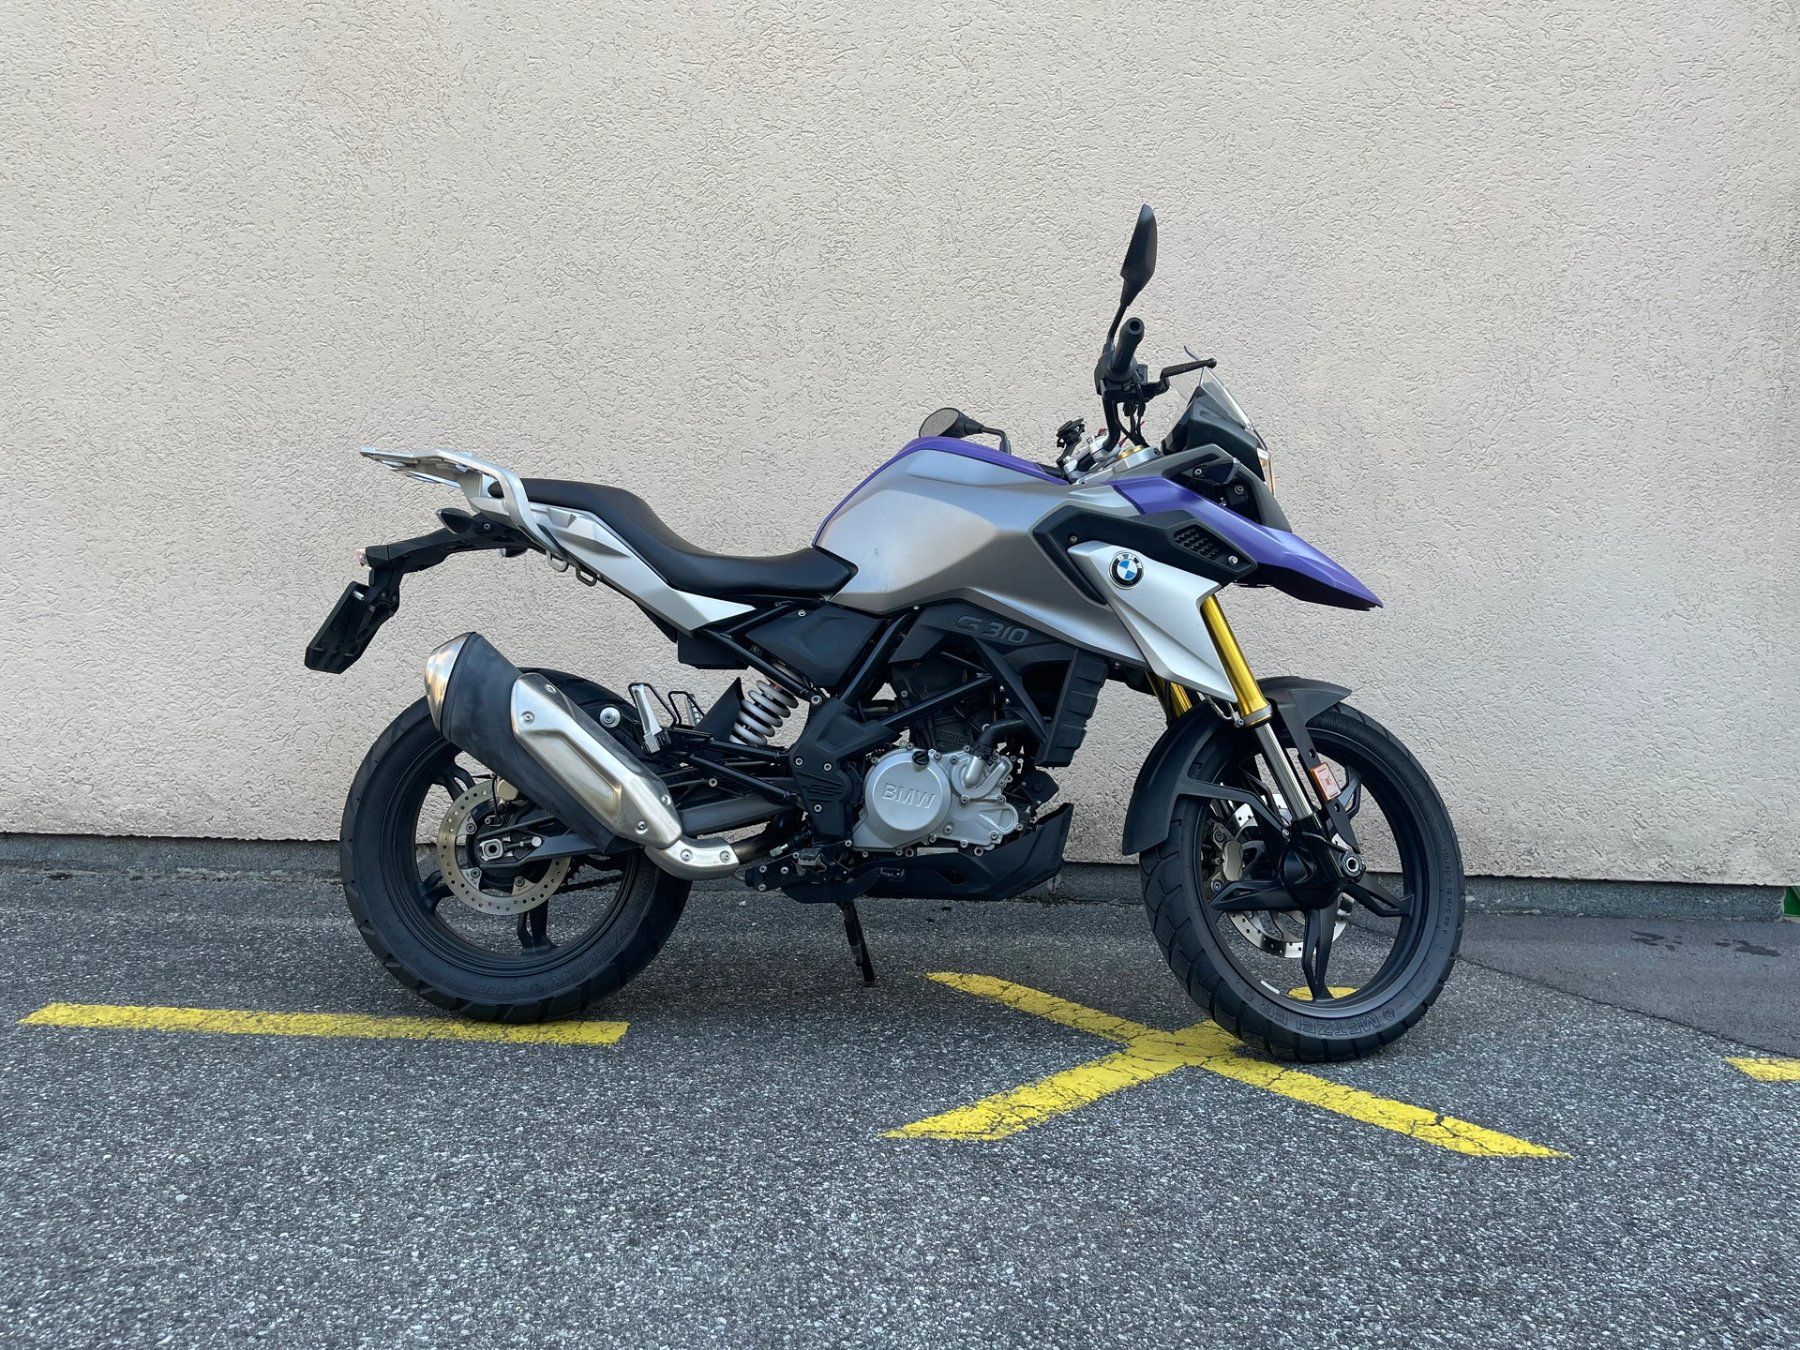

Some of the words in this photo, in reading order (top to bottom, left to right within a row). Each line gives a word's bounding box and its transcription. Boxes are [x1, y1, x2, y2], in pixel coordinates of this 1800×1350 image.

[956, 616, 982, 632] G
[982, 622, 1030, 643] 310
[881, 783, 936, 809] BMW
[550, 874, 654, 988] METZELER
[1259, 1001, 1382, 1036] METZELER
